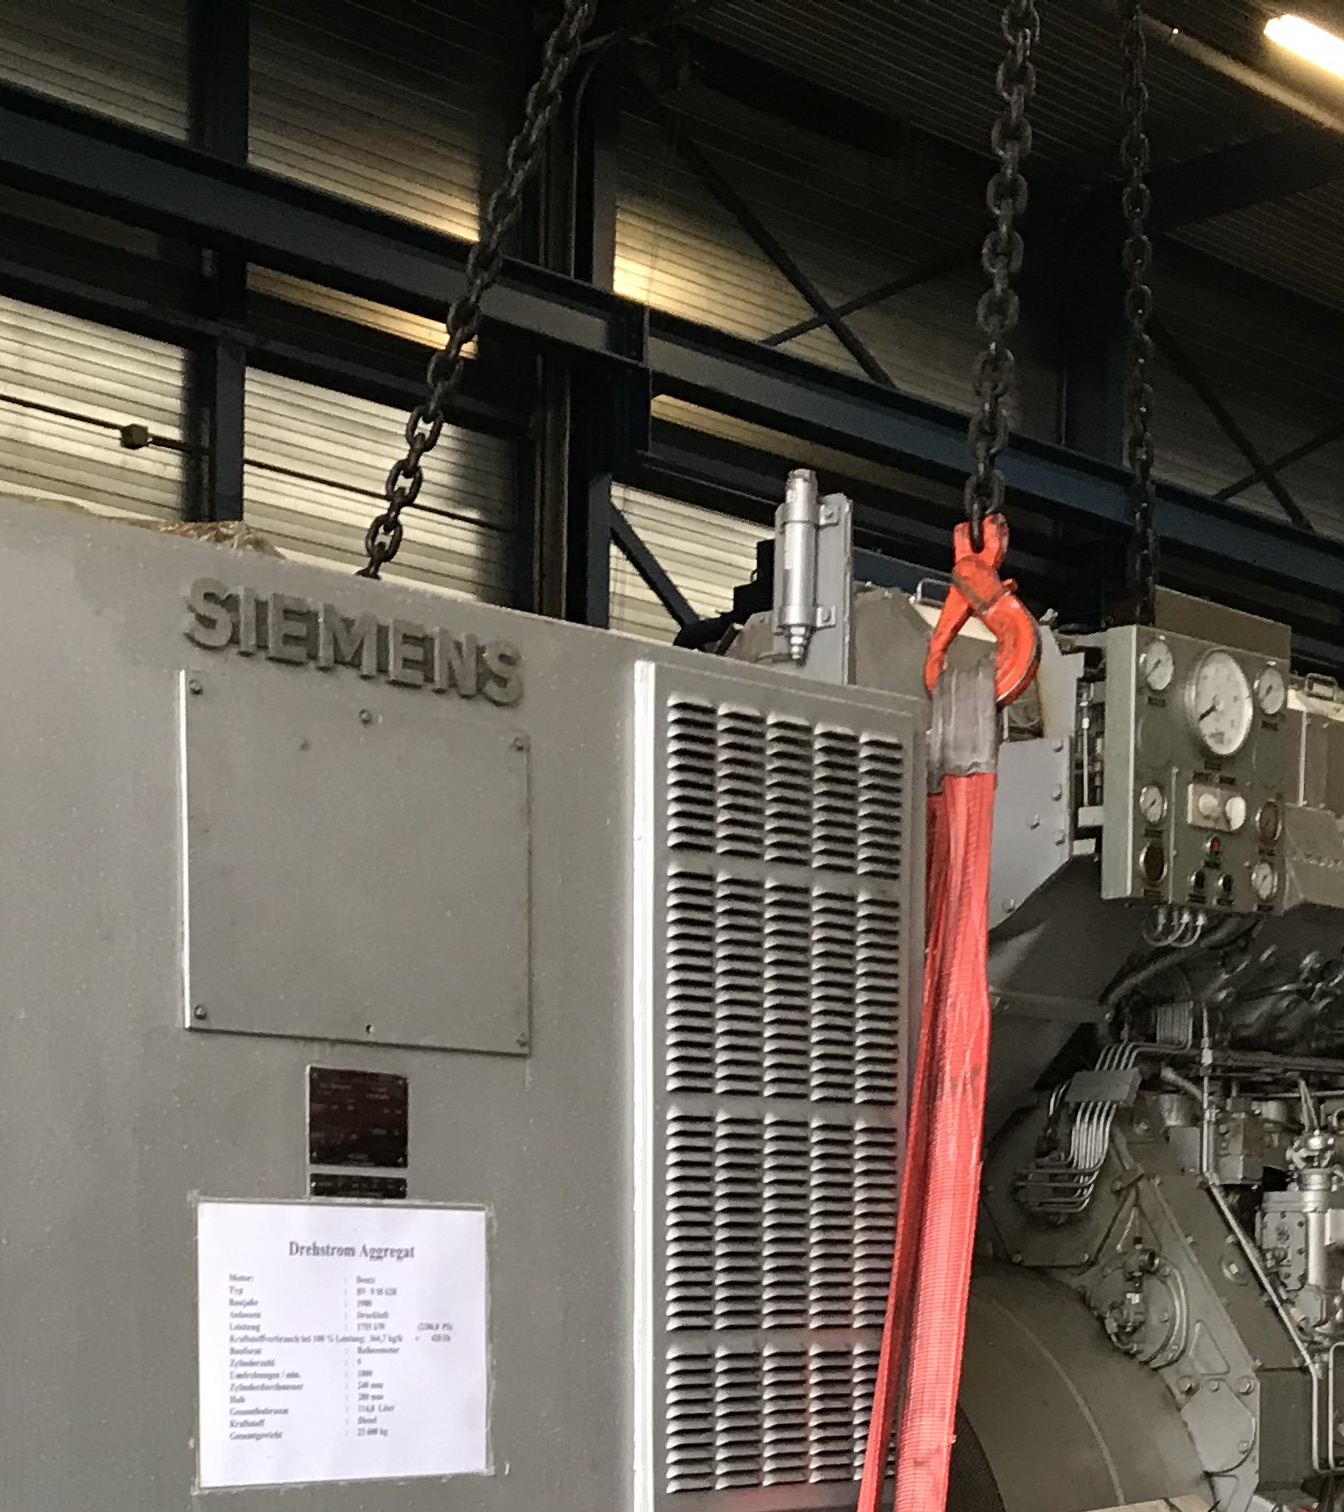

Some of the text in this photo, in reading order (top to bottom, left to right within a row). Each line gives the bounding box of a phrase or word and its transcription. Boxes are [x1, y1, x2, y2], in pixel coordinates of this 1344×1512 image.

[183, 577, 525, 707] SIEMENS
[288, 1240, 415, 1262] Drehstrom Aggregat
